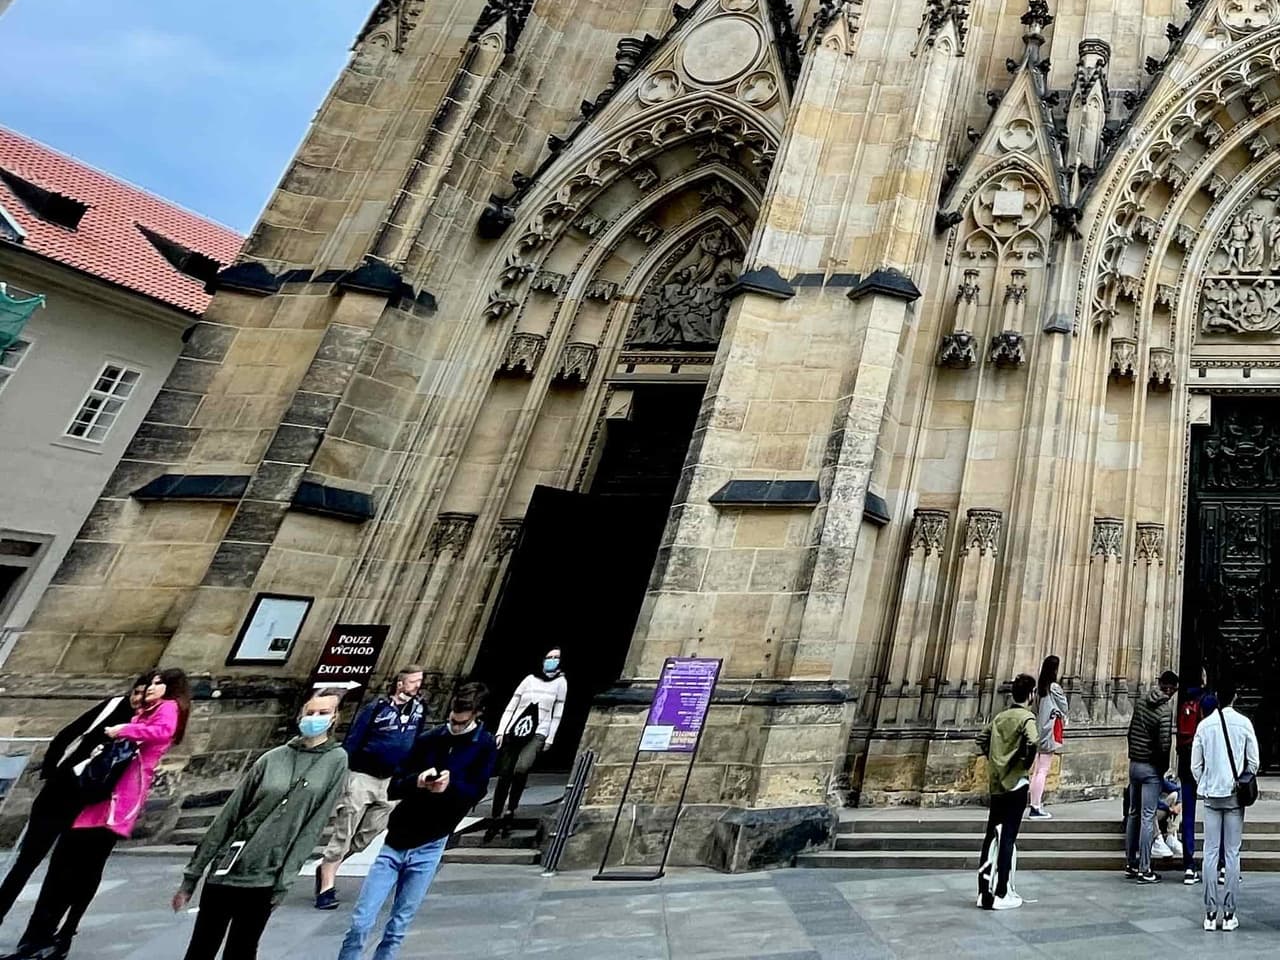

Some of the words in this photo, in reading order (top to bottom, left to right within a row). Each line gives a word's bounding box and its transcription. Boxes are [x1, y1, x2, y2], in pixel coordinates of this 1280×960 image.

[337, 634, 373, 644] POUZE
[317, 664, 342, 674] EXIT
[342, 665, 373, 674] ONLY
